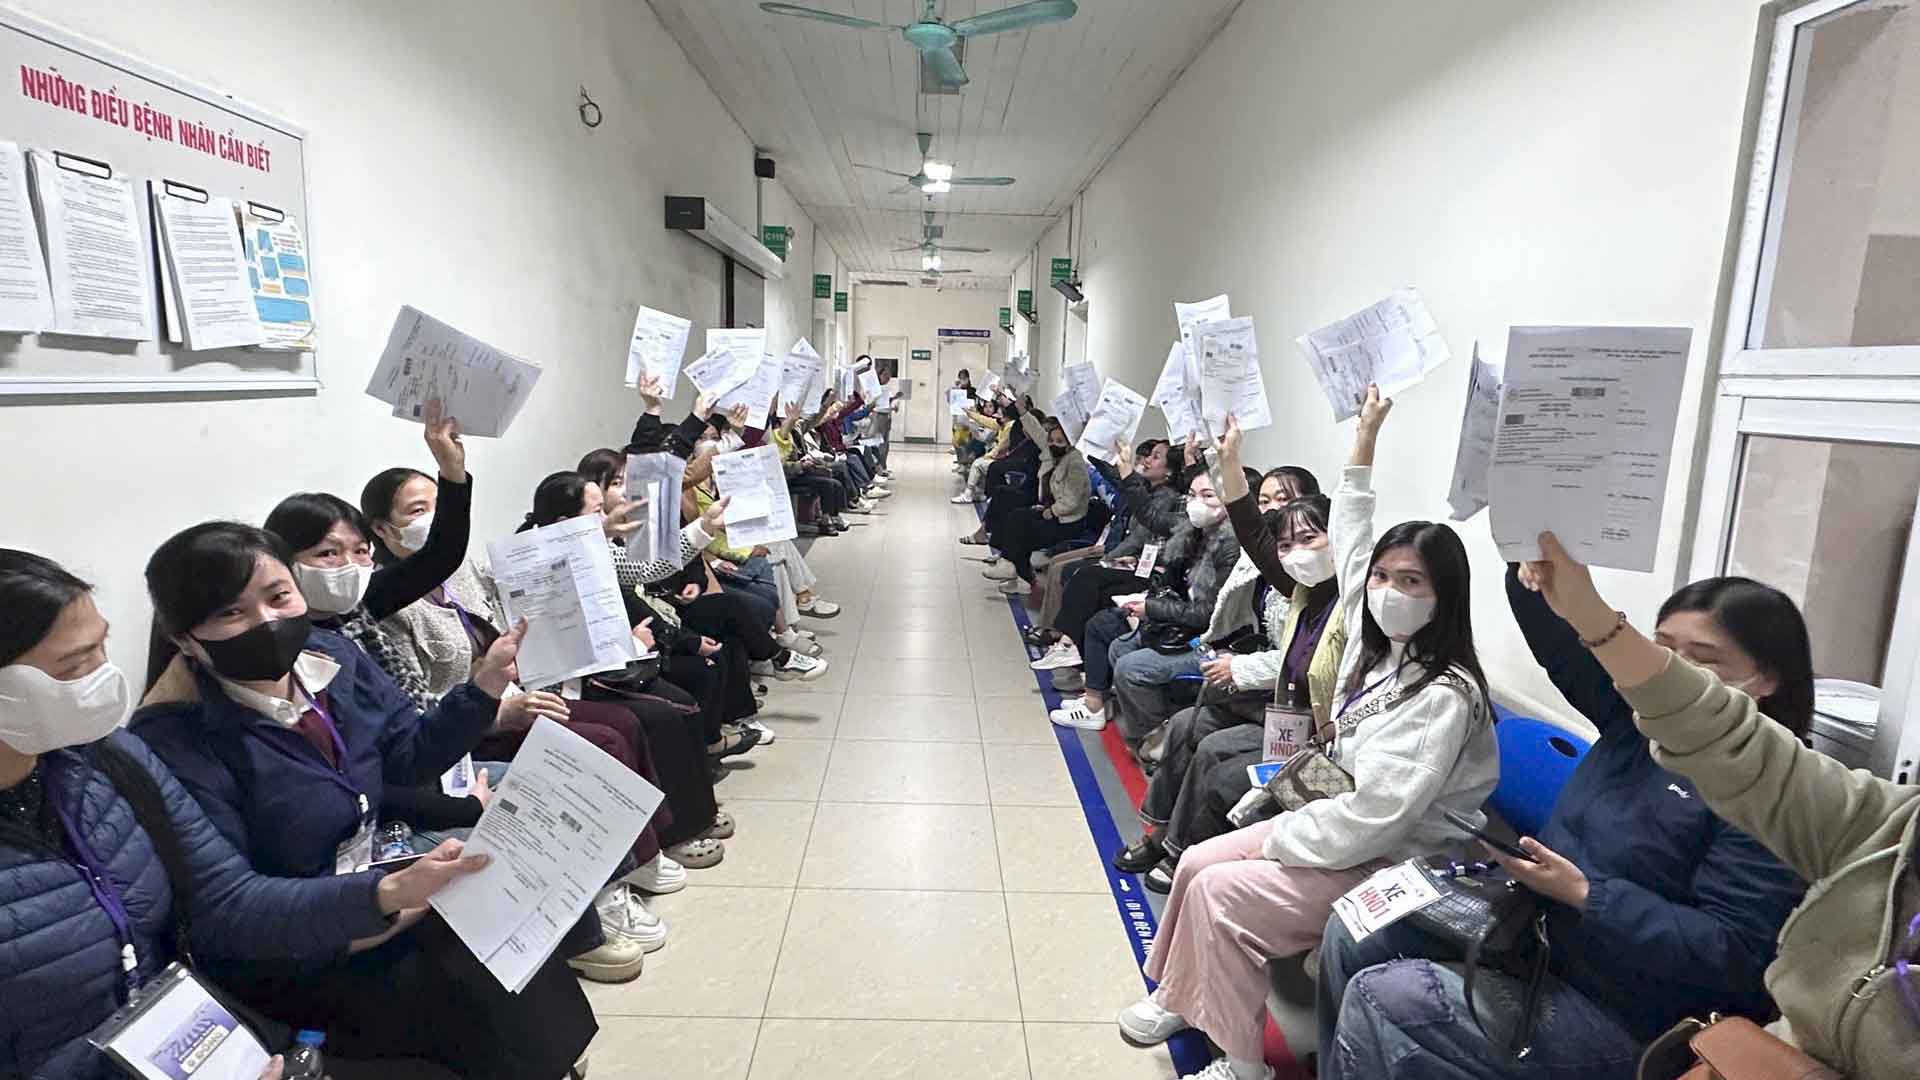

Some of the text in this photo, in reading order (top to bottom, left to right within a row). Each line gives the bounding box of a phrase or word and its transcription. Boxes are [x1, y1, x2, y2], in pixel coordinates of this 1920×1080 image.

[20, 65, 271, 173] NHỮNG ĐIỀU BỆNH NHÂN CẦN BIẾT
[1279, 728, 1294, 742] XE
[1358, 886, 1391, 920] HN01
[1381, 883, 1406, 902] XE
